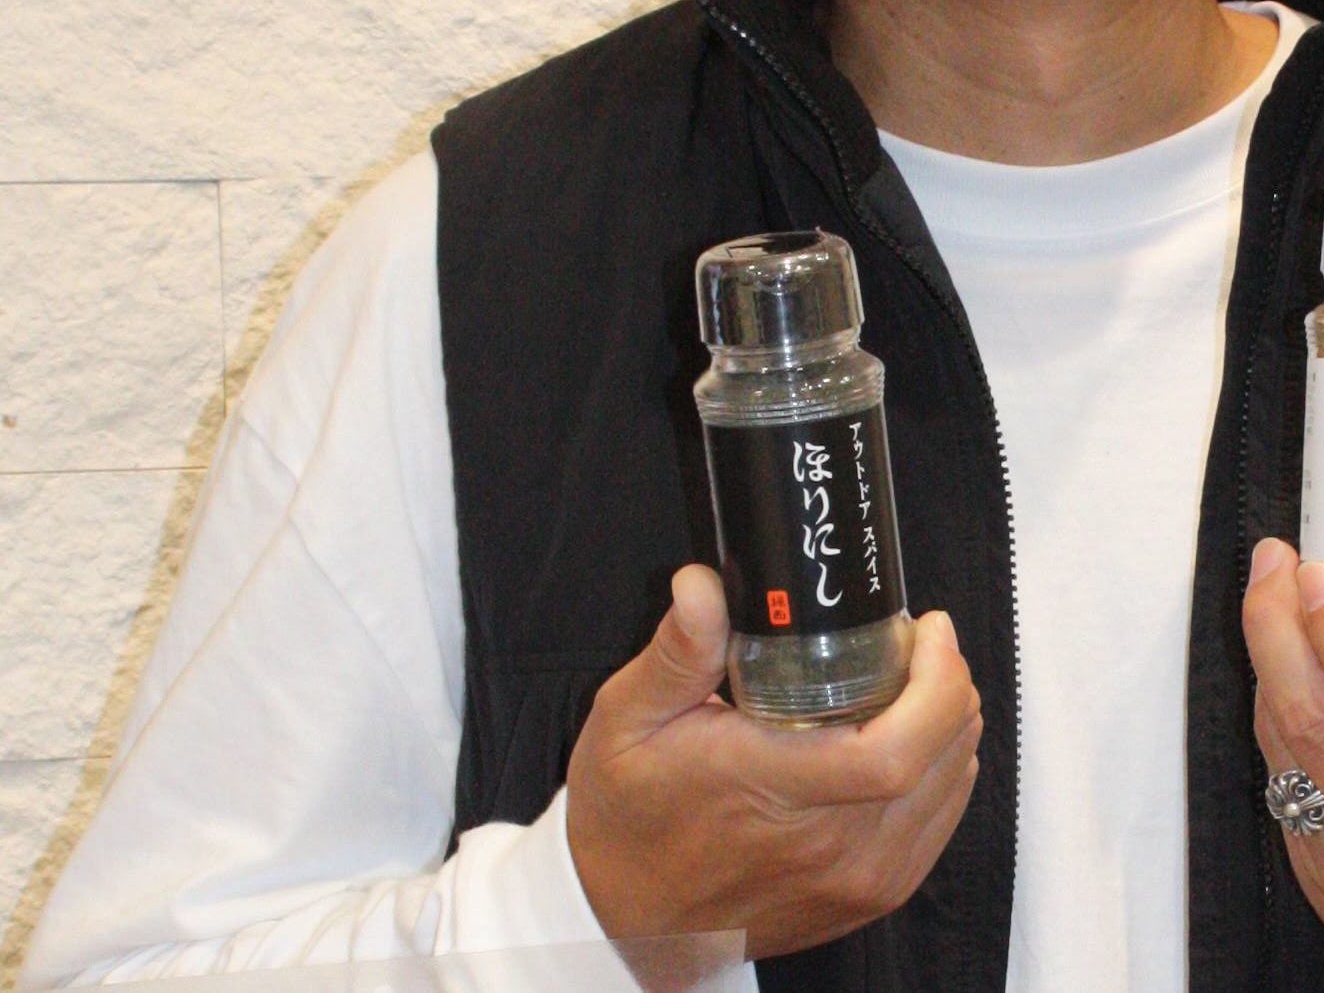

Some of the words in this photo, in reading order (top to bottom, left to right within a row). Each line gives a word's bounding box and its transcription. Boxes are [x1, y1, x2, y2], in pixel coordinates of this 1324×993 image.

[793, 441, 843, 607] ほりにし
[849, 422, 871, 520] アウトドア
[863, 526, 881, 594] スパイス
